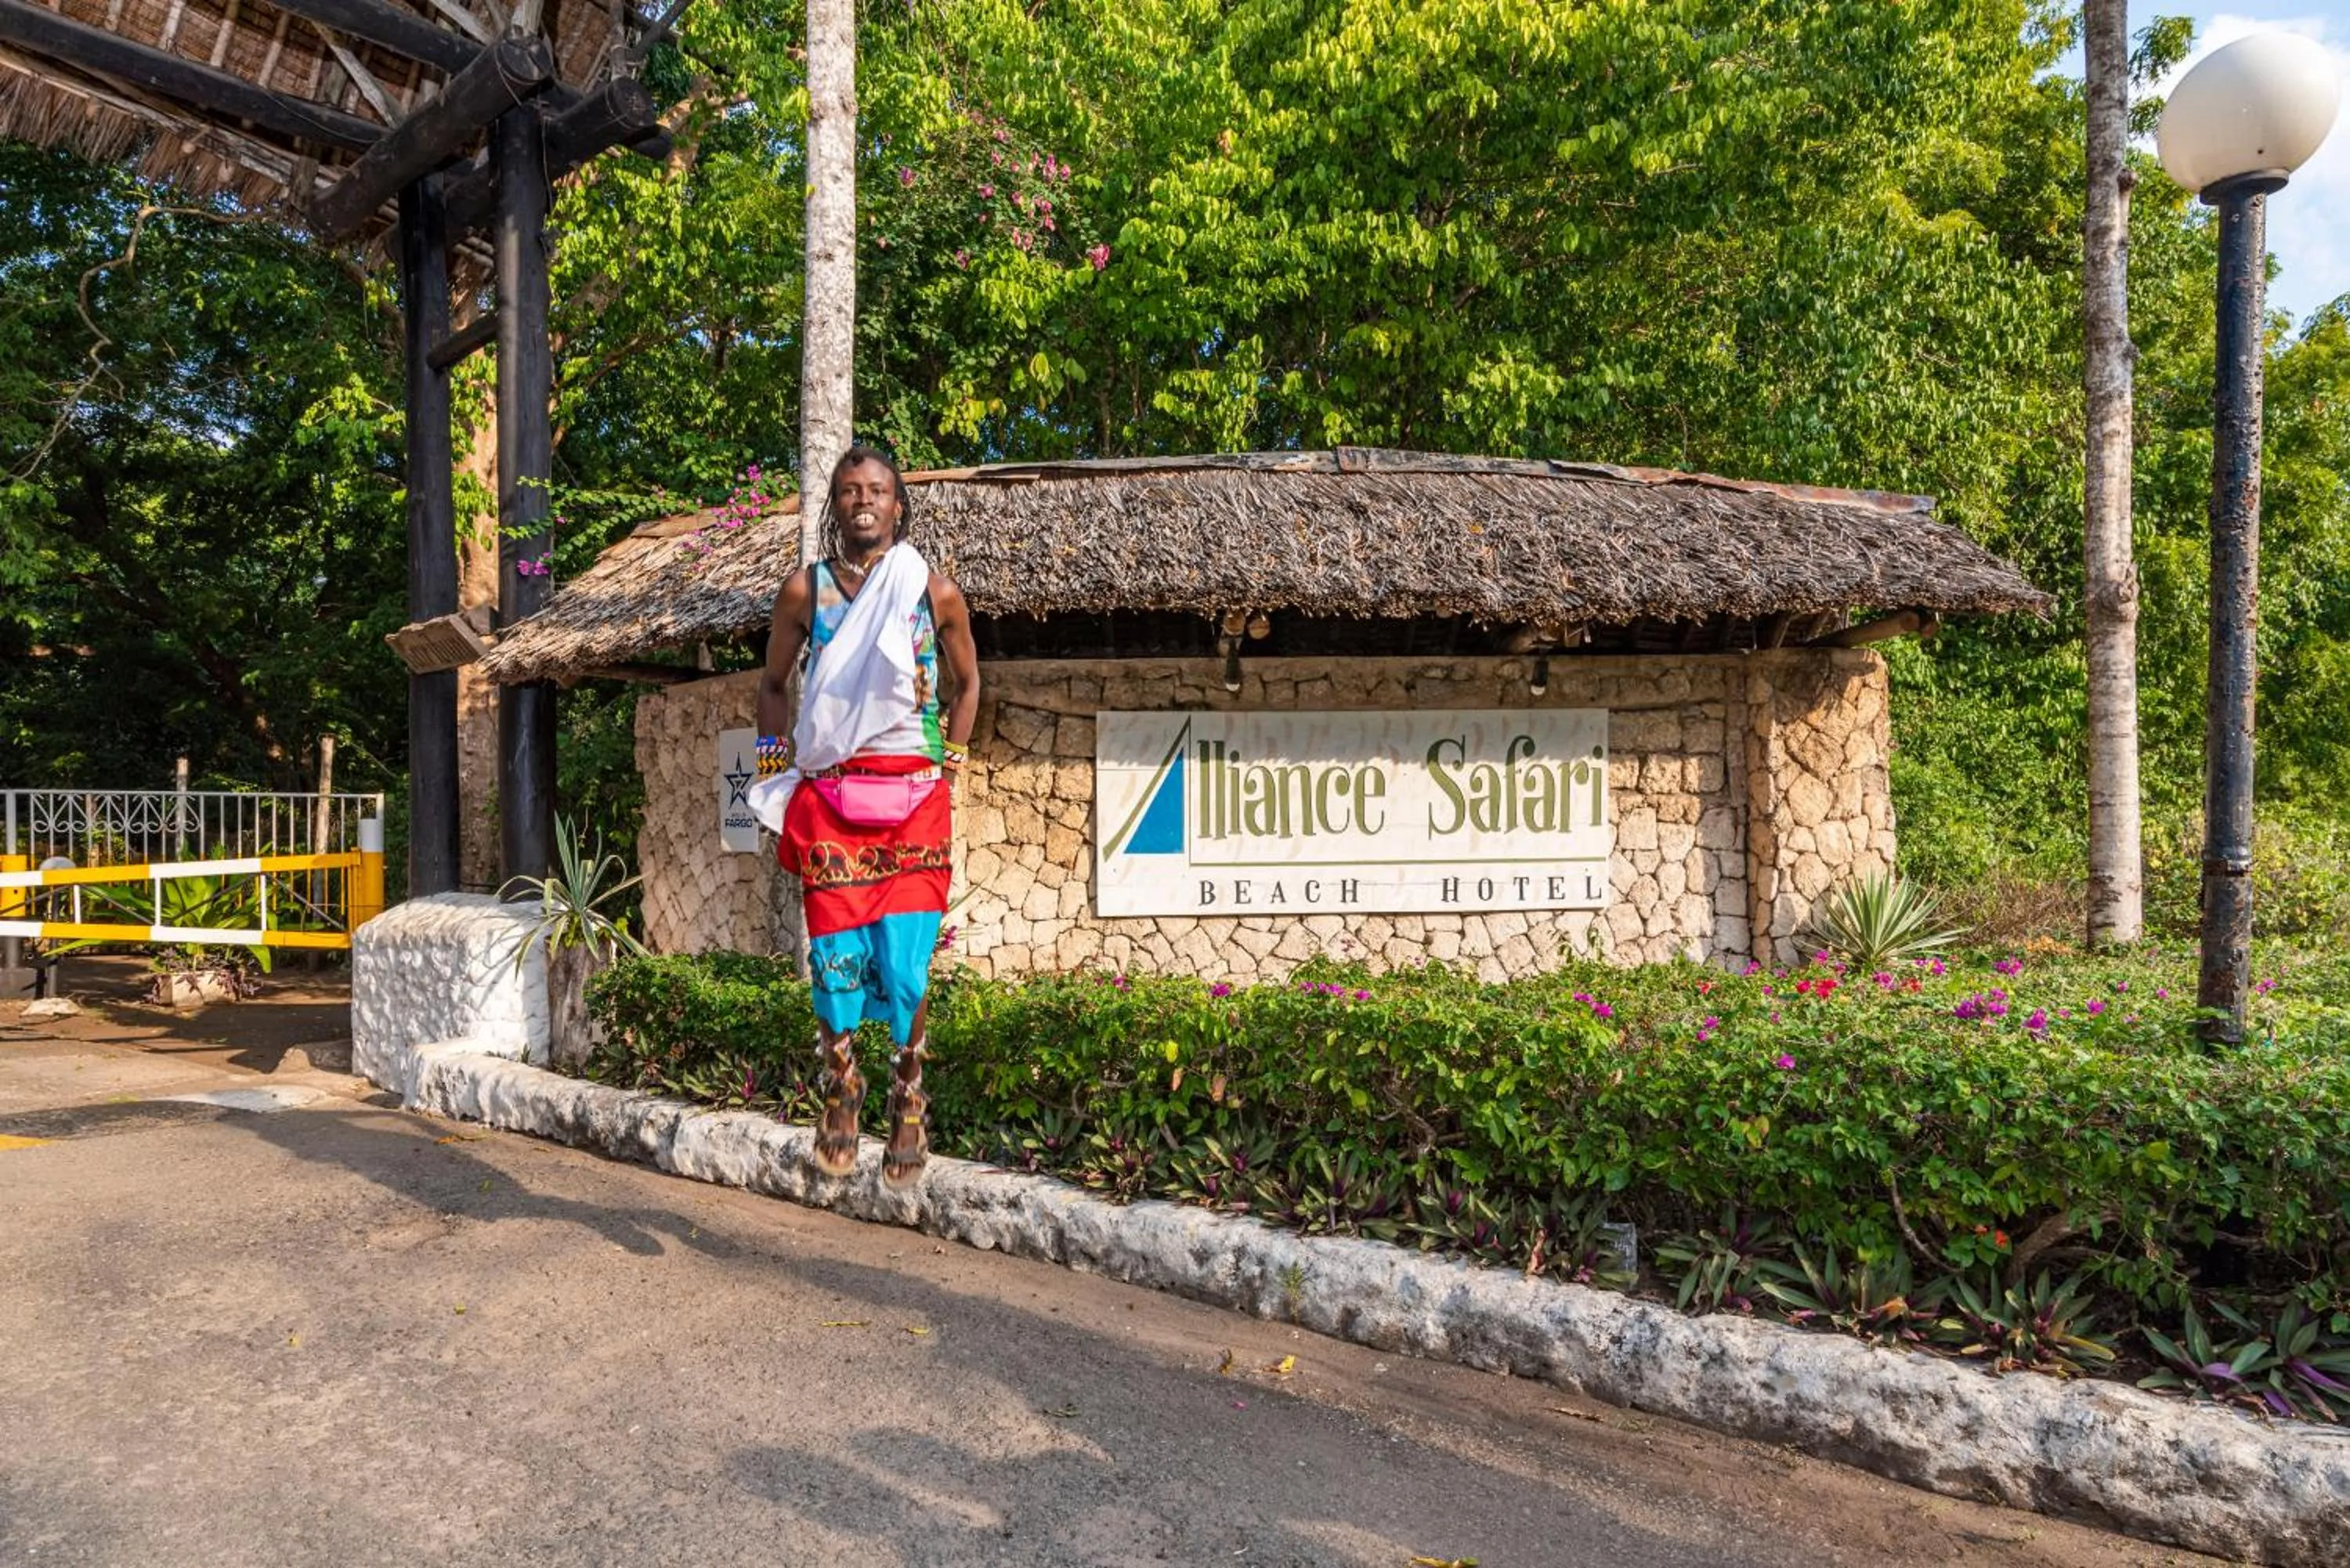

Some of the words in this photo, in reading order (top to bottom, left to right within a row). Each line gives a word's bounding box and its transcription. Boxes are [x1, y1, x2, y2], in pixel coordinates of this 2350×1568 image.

[1426, 735, 1604, 840] Safari
[725, 818, 753, 828] FARGO
[1198, 879, 1360, 906] BEACH
[1441, 876, 1603, 903] HOTEL
